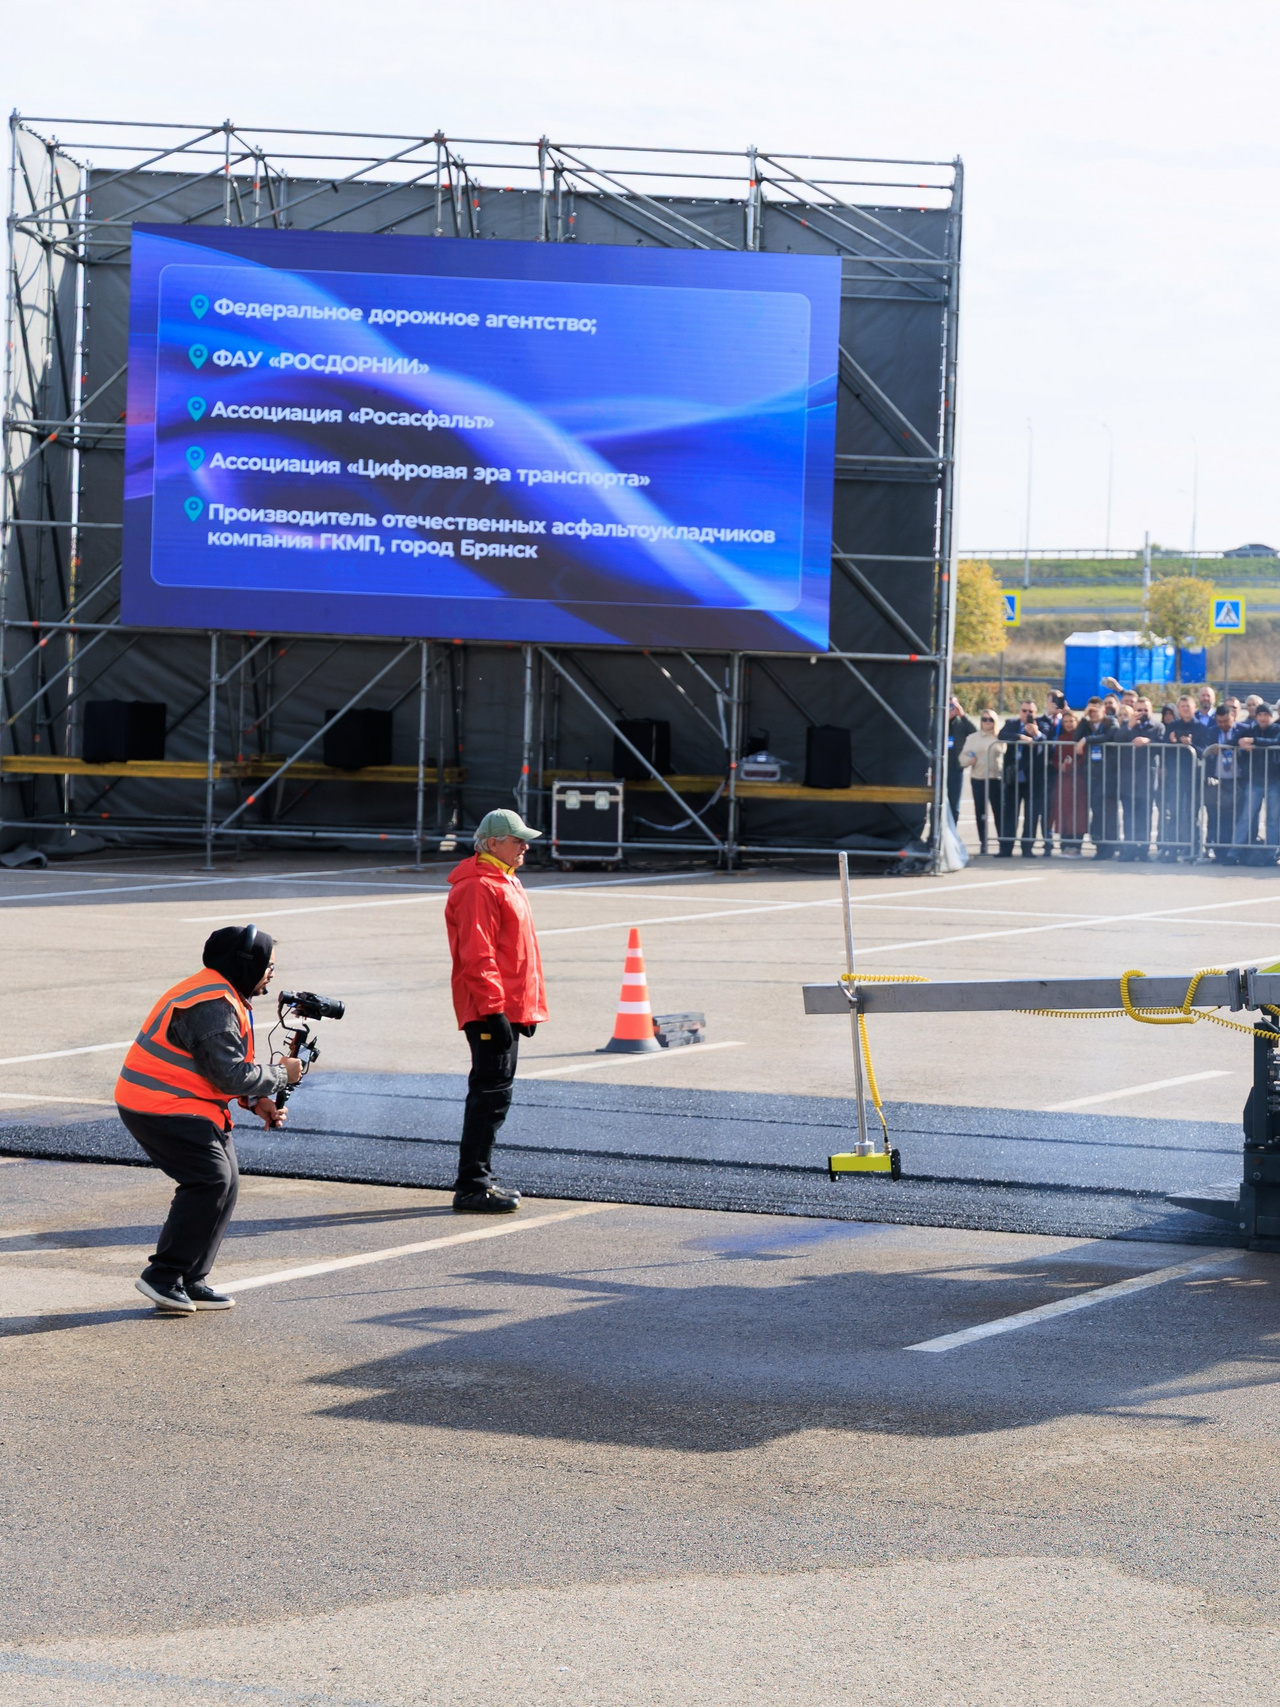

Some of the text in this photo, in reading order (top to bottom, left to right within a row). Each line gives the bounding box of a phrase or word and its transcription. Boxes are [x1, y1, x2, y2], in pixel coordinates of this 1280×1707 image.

[214, 297, 597, 334] Федеральное дорожное агентство;
[212, 349, 430, 375] ФАУ «РОСДОРНИИ»
[211, 401, 495, 431] Ассоциация «Росасфальт»
[209, 452, 651, 488] Ассоциация «Цифровая эра транспорта»
[208, 503, 776, 543] Производитель отечественных асфальтоукладчиков
[208, 531, 538, 560] компания ГКМП, город Брянск
